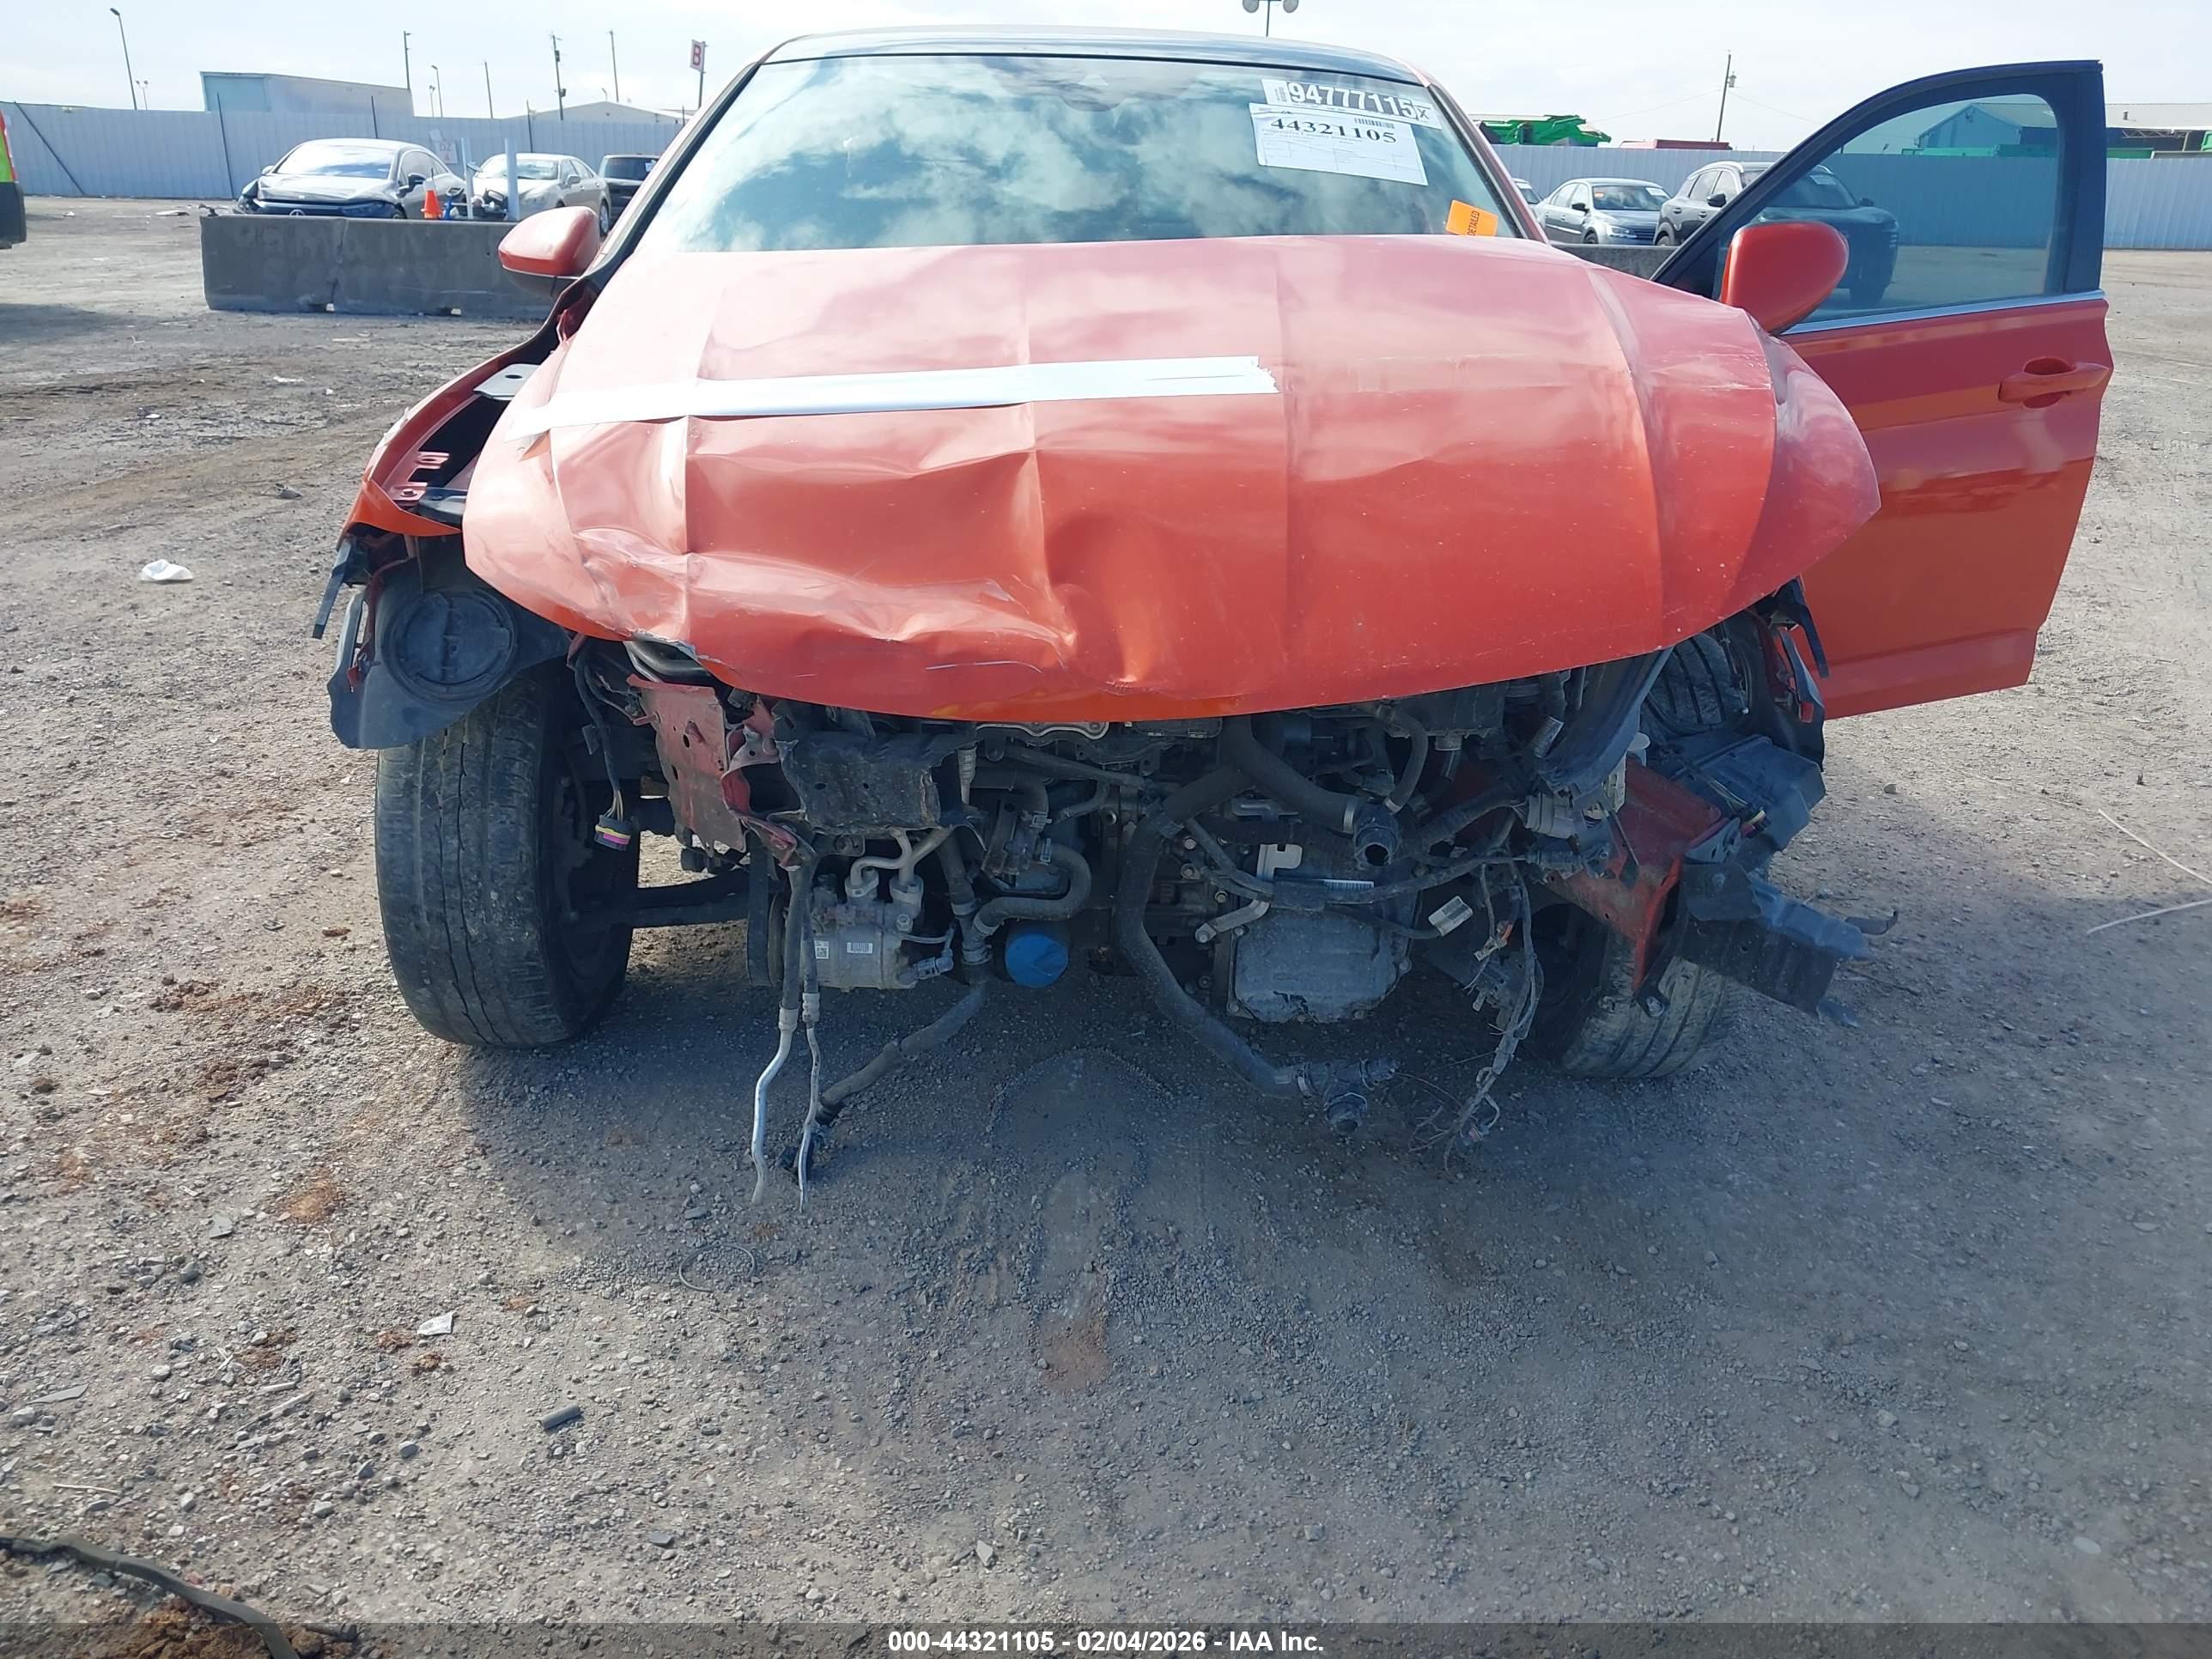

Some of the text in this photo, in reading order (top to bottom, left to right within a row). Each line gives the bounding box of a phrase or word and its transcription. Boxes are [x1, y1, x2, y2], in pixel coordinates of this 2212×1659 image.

[692, 44, 702, 66] B
[1288, 82, 1418, 118] 94777115
[1271, 118, 1396, 143] 44321105
[1468, 210, 1480, 236] DETAILED
